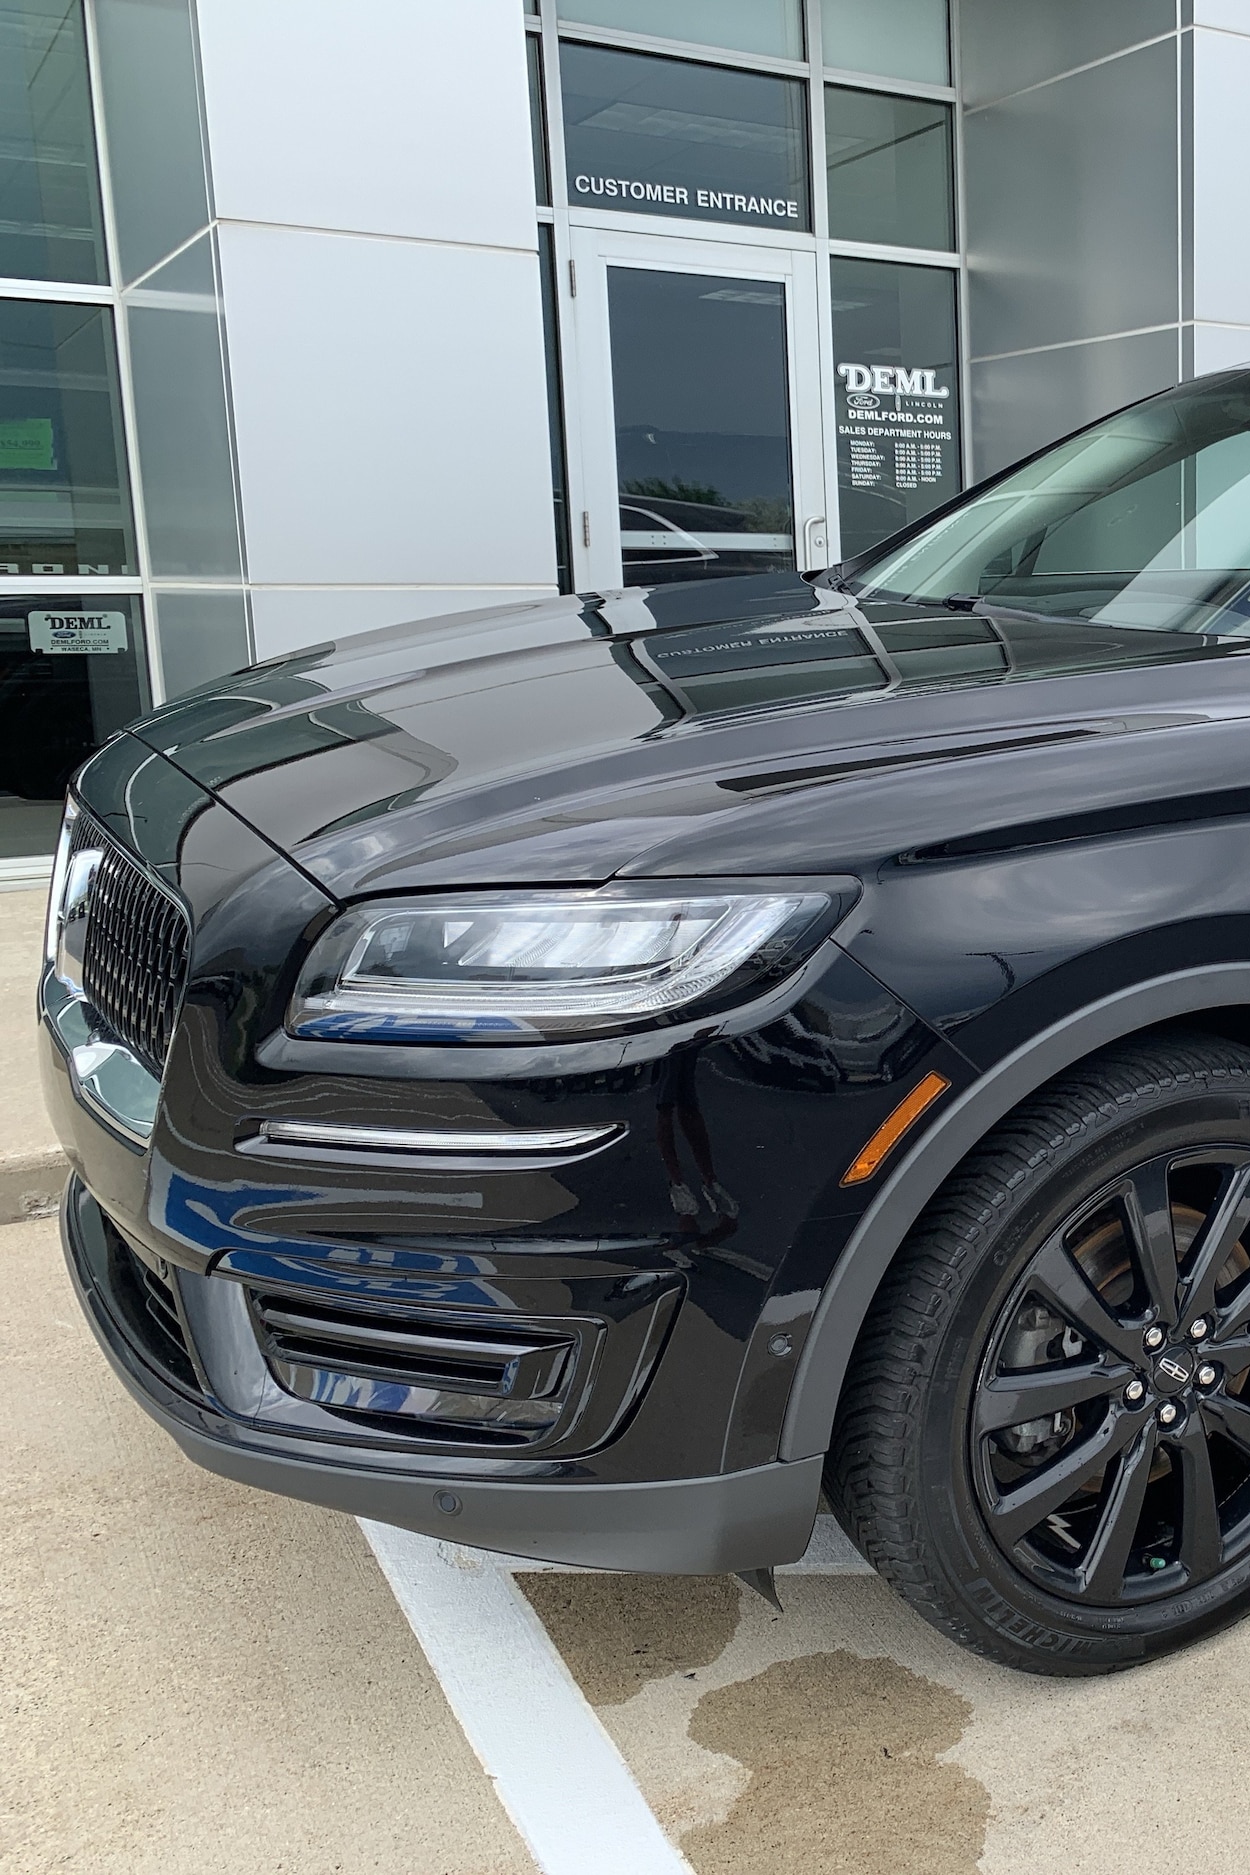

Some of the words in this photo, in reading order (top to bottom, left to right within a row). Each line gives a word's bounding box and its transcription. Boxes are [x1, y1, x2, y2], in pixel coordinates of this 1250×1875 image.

[575, 174, 689, 206] CUSTOMER
[696, 189, 799, 219] ENTRANCE
[838, 363, 949, 398] DEML
[853, 396, 874, 407] Ford
[905, 400, 944, 409] LINCOLN
[848, 410, 943, 424] DEMLFORD.COM
[839, 425, 866, 436] SALES
[868, 427, 922, 439] DEPARTMENT
[923, 430, 952, 441] HOURS
[44, 617, 111, 630] DEML
[972, 1585, 1094, 1655] MICHELIN
